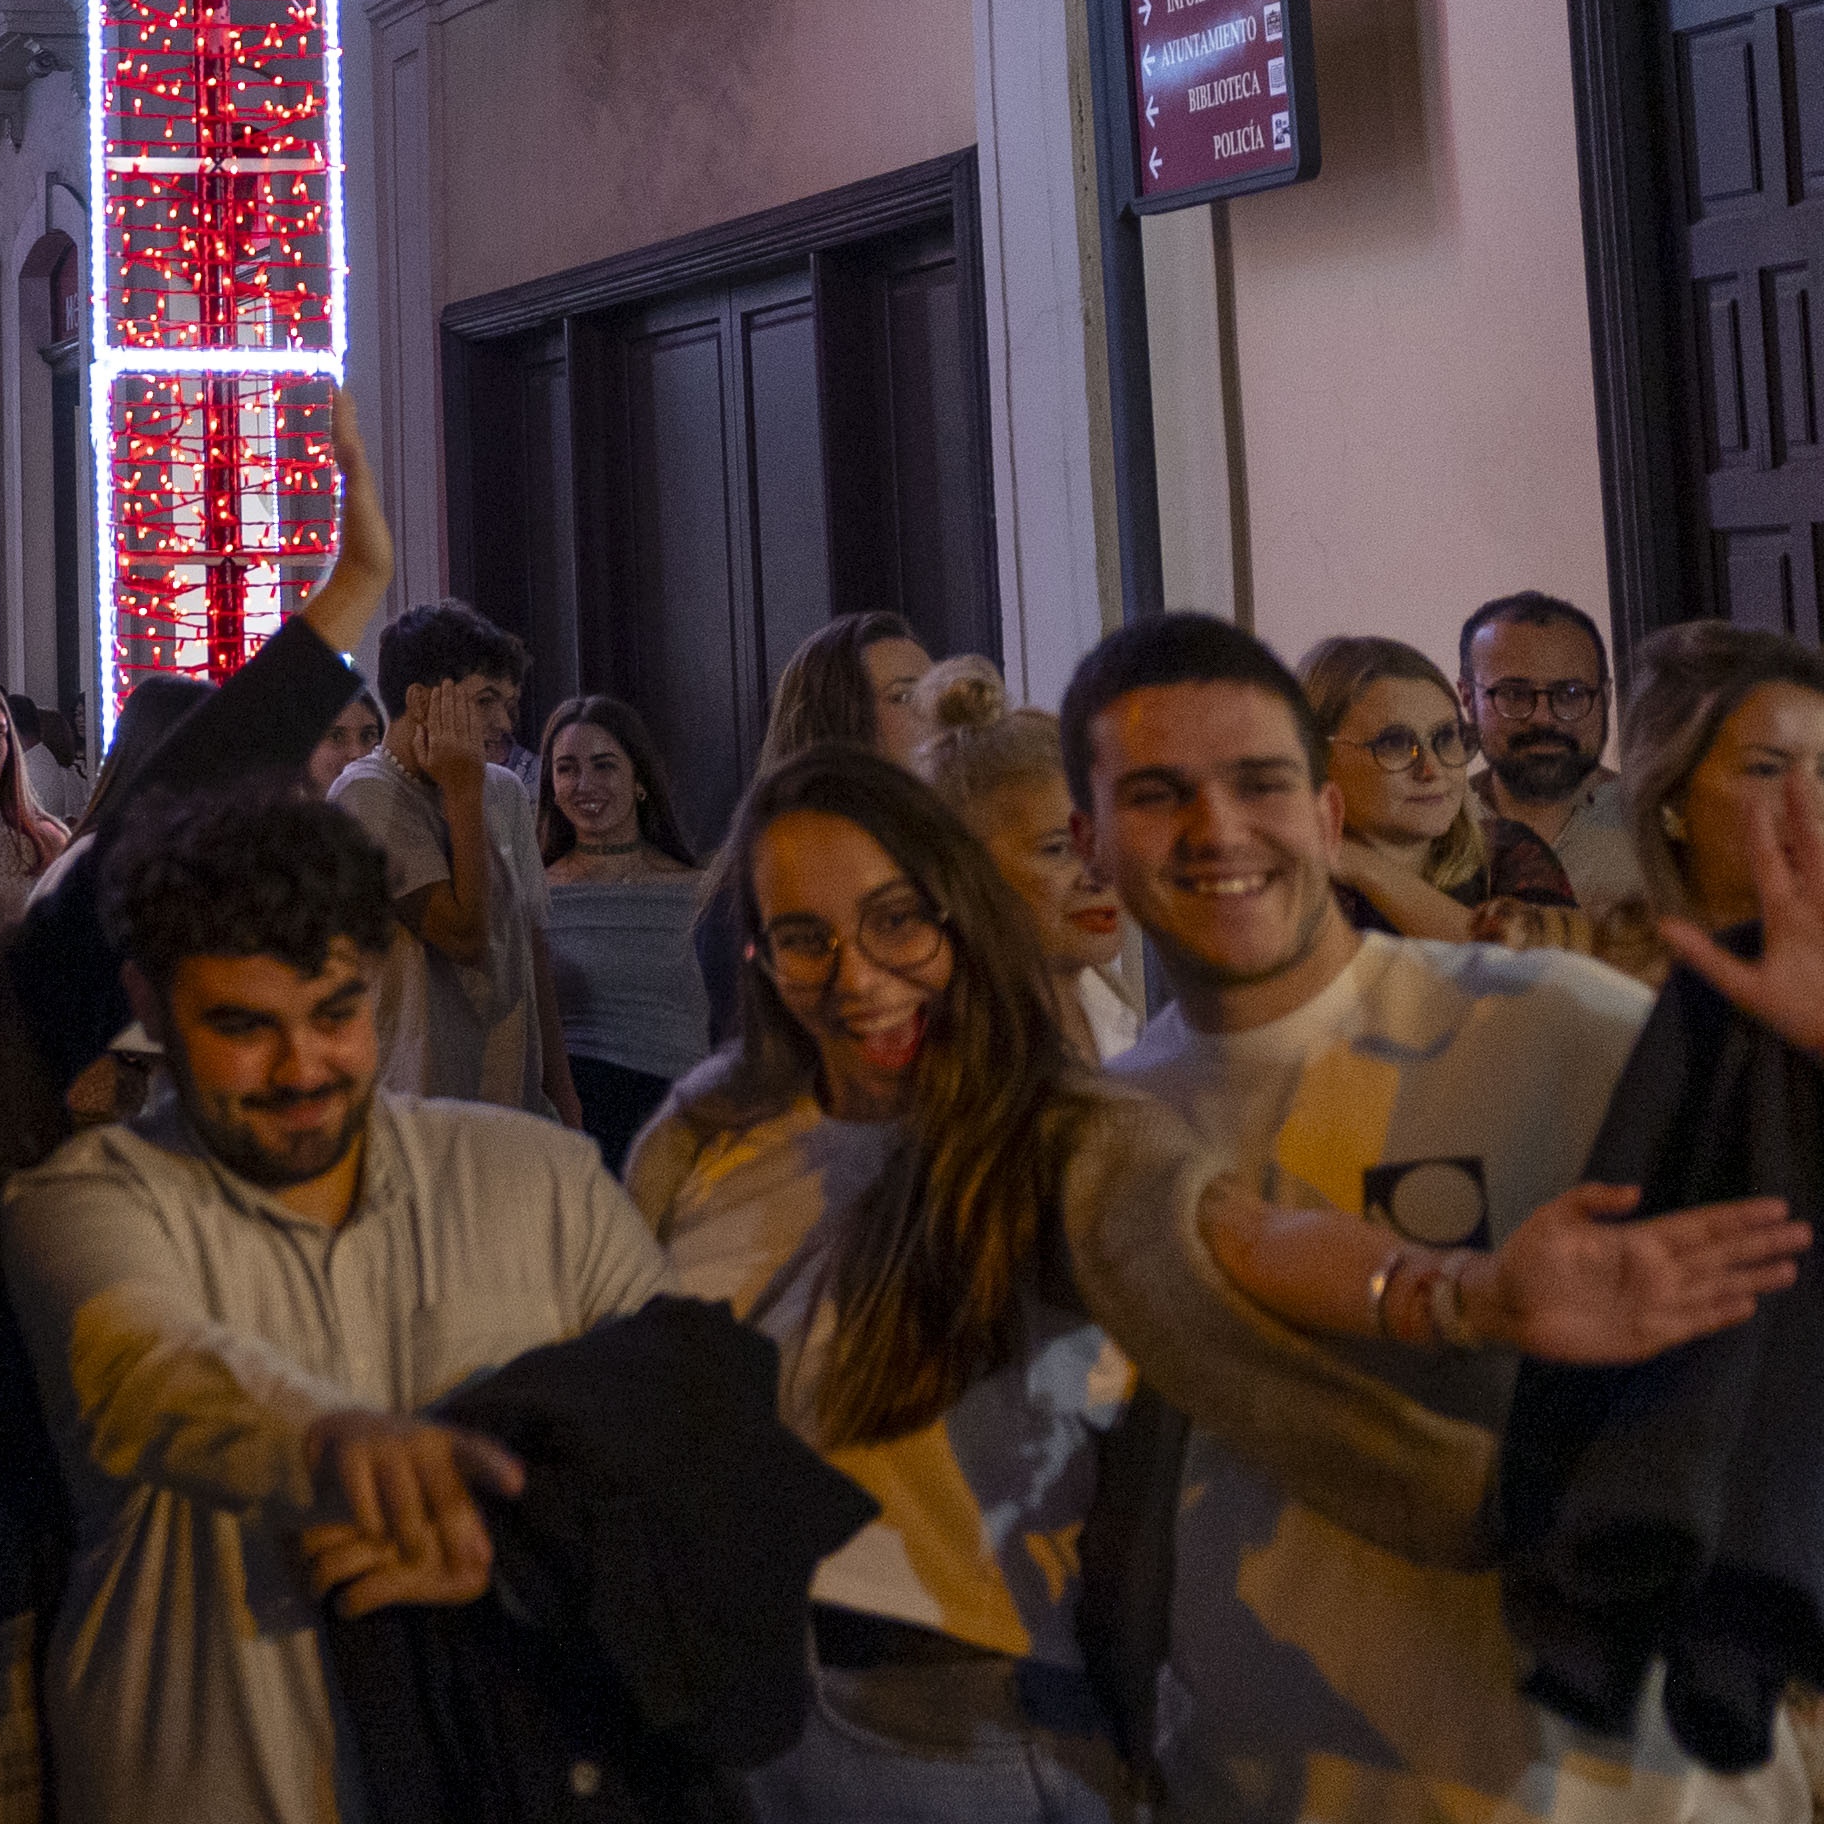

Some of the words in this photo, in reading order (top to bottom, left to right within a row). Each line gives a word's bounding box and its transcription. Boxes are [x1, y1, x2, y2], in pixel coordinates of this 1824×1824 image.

[1161, 16, 1257, 67] AYUNTAMIENTO
[1187, 71, 1262, 113] BIBLIOTECA
[1213, 119, 1265, 161] POLICÍA
